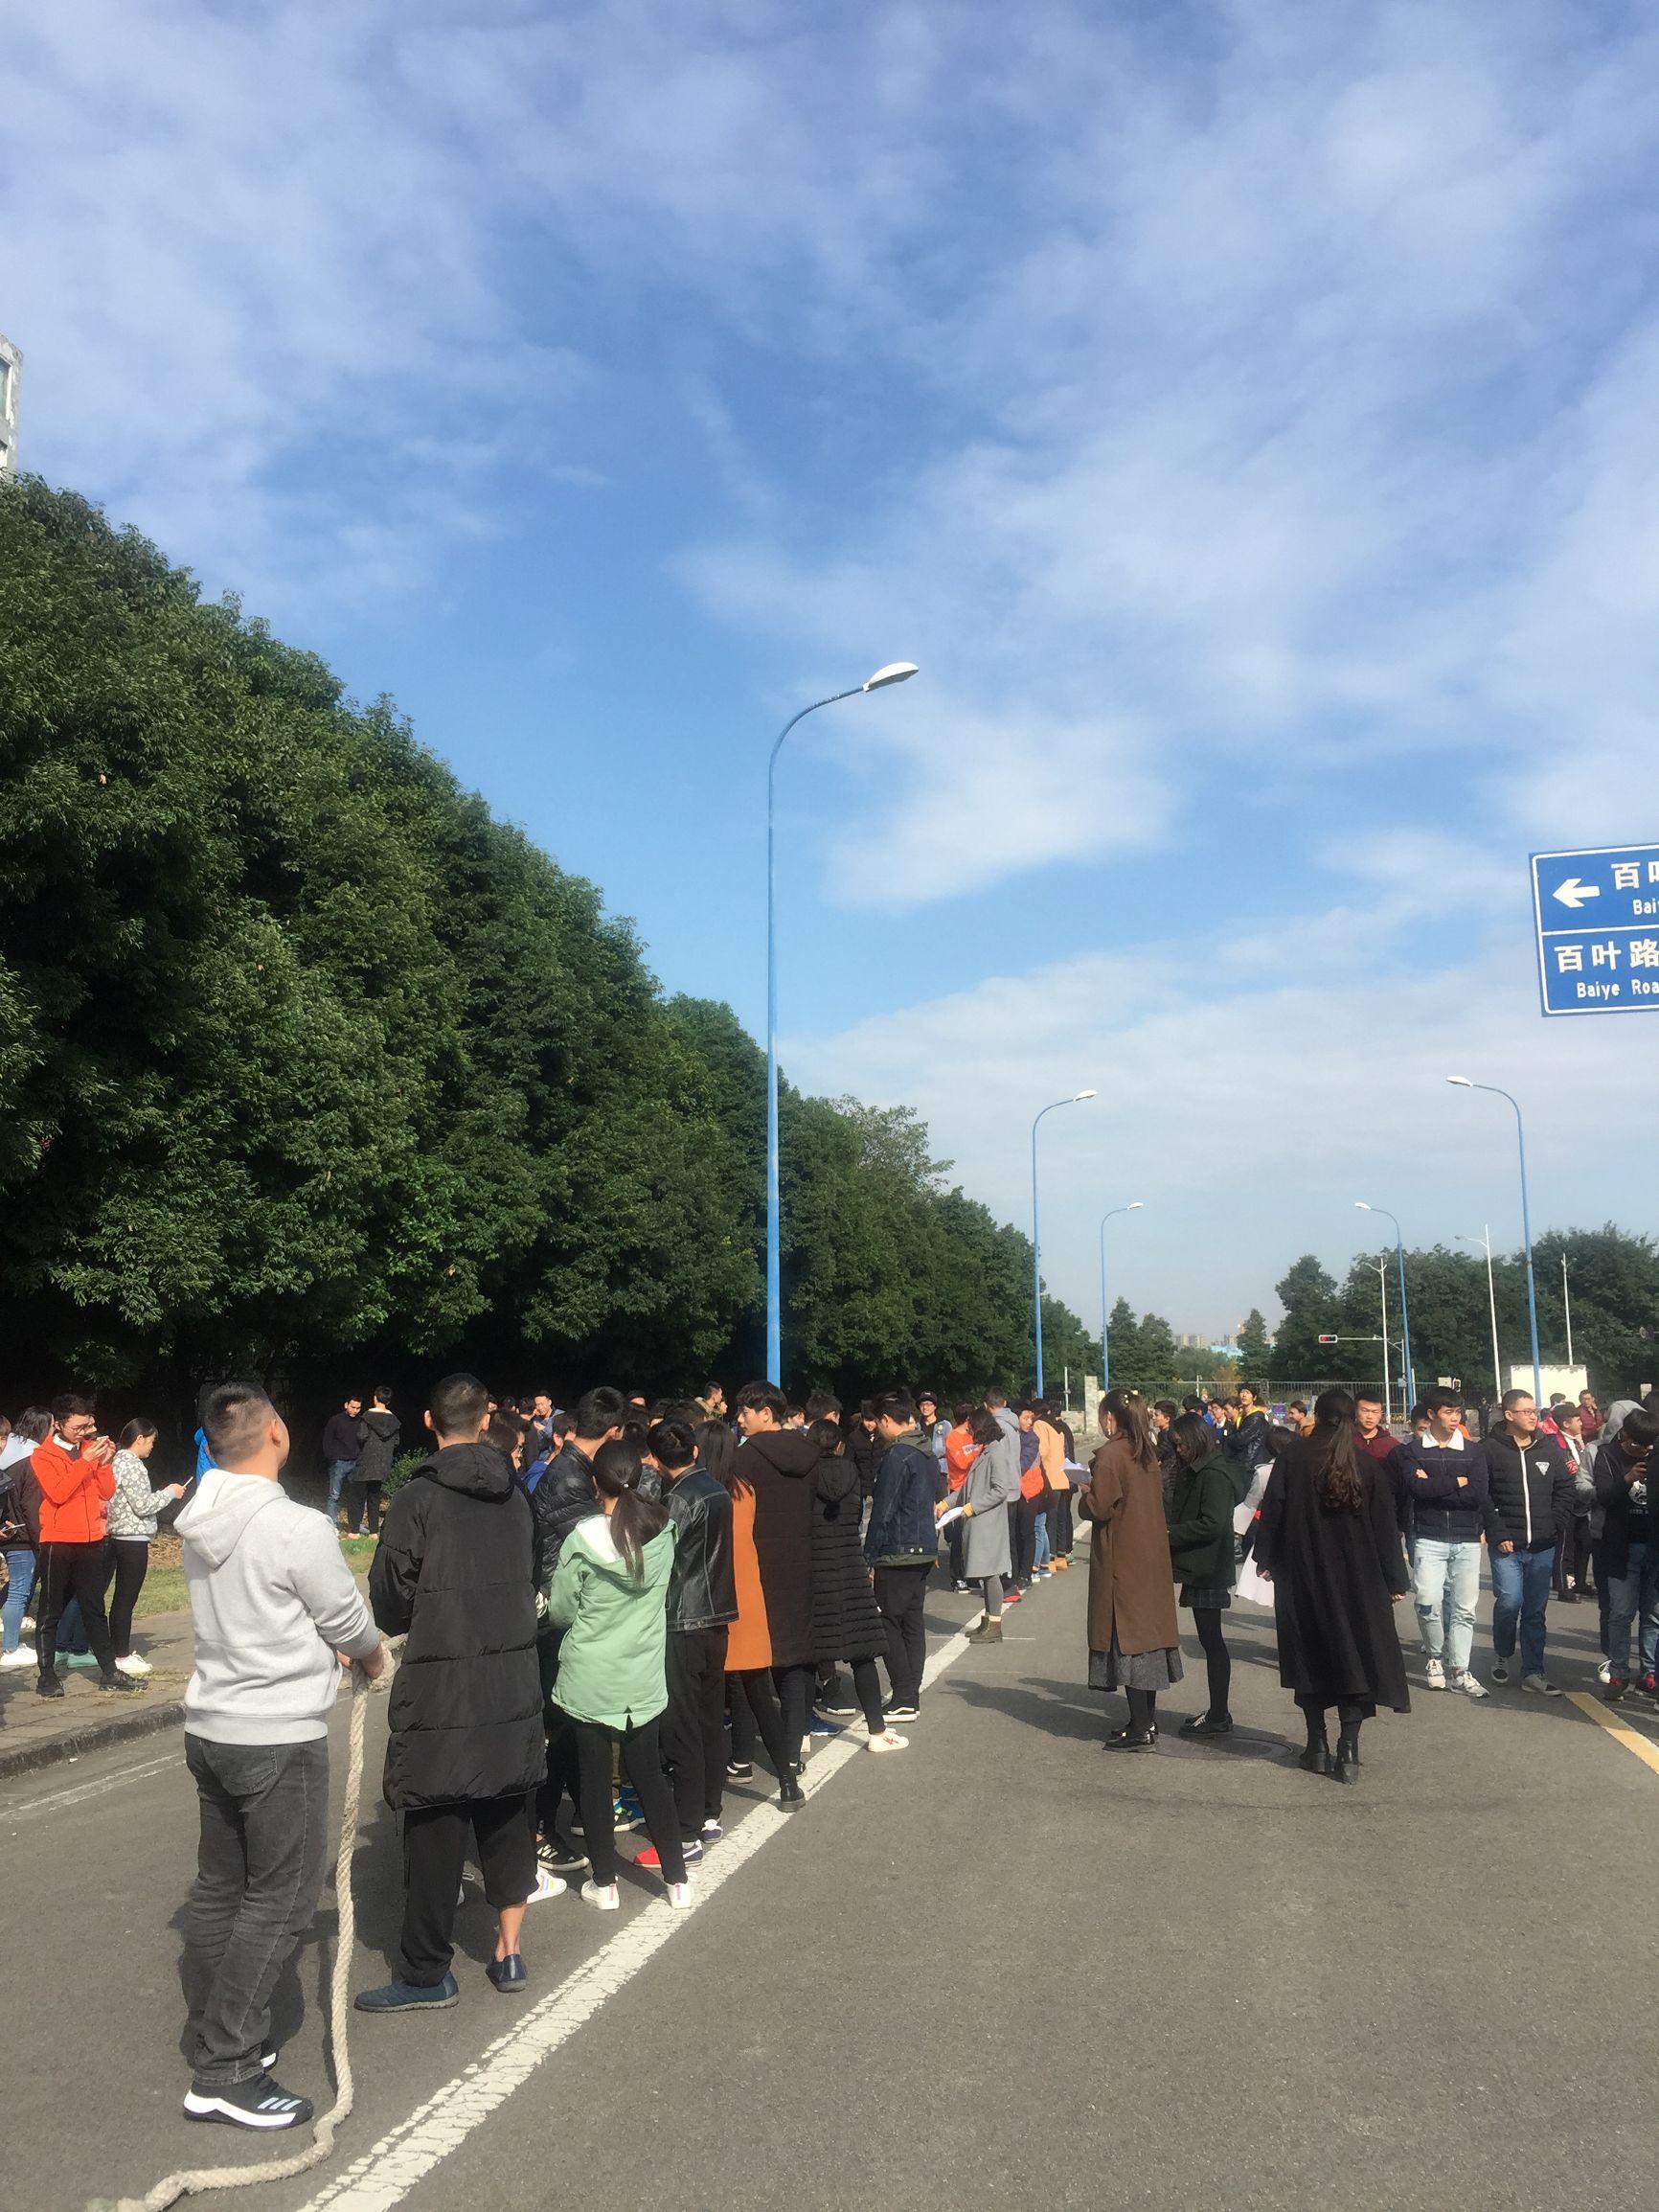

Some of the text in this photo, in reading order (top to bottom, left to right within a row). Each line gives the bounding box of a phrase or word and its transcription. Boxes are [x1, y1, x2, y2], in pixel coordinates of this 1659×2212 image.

[1632, 899, 1659, 916] Bai
[1554, 939, 1659, 973] 百叶路
[1577, 980, 1621, 1001] Baiye
